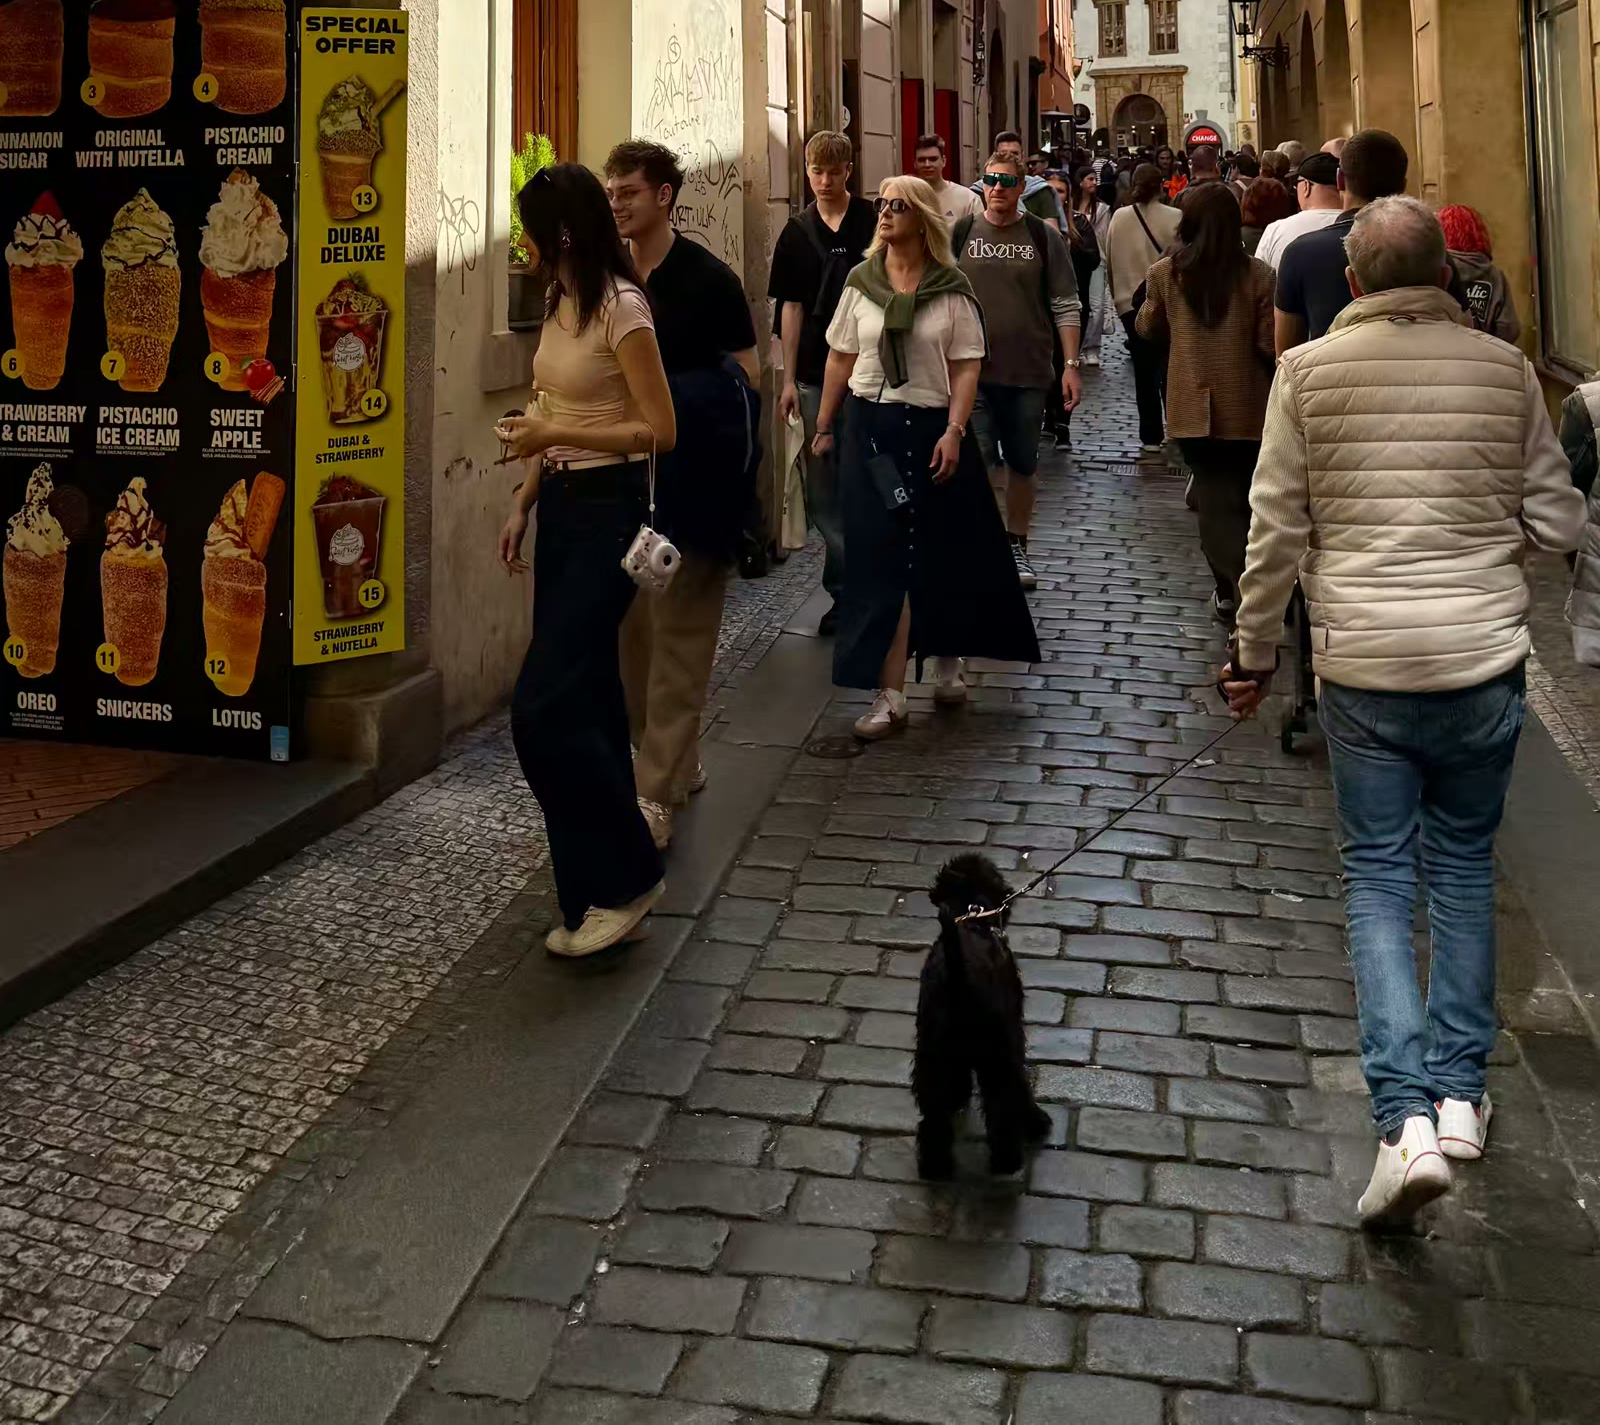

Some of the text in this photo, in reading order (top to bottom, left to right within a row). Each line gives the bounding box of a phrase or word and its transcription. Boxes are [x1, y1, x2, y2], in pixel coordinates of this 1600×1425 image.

[305, 16, 405, 34] SPECIAL
[315, 37, 396, 54] OFFER
[88, 85, 97, 99] 3
[201, 81, 210, 95] 4
[95, 129, 166, 148] ORIGINAL
[204, 126, 285, 145] PISTACHIO
[1191, 134, 1218, 142] CHANGE
[0, 152, 48, 169] SUGAR
[75, 149, 185, 168] WITH NUTELLA
[216, 147, 272, 165] CREAM
[355, 192, 373, 206] 13
[327, 226, 380, 245] DUBAI
[320, 245, 386, 264] DELUXE
[8, 357, 17, 372] 6
[108, 359, 117, 374] 7
[212, 360, 222, 375] 8
[365, 396, 382, 410] 14
[99, 406, 178, 425] PISTACHIO
[209, 408, 265, 427] SWEET
[1, 424, 70, 443] & CREAM
[96, 427, 180, 447] ICE CREAM
[210, 430, 262, 448] APPLE
[327, 434, 370, 449] DUBAI &
[315, 446, 385, 464] STRAWBERRY
[362, 586, 380, 602] 15
[313, 621, 385, 642] STRAWBERRY
[8, 644, 24, 659] 10
[320, 637, 378, 655] & NUTELLA
[100, 651, 115, 667] 11
[209, 659, 226, 675] 12
[17, 691, 57, 712] OREO
[96, 697, 173, 722] SNICKERS
[212, 708, 262, 730] LOTUS
